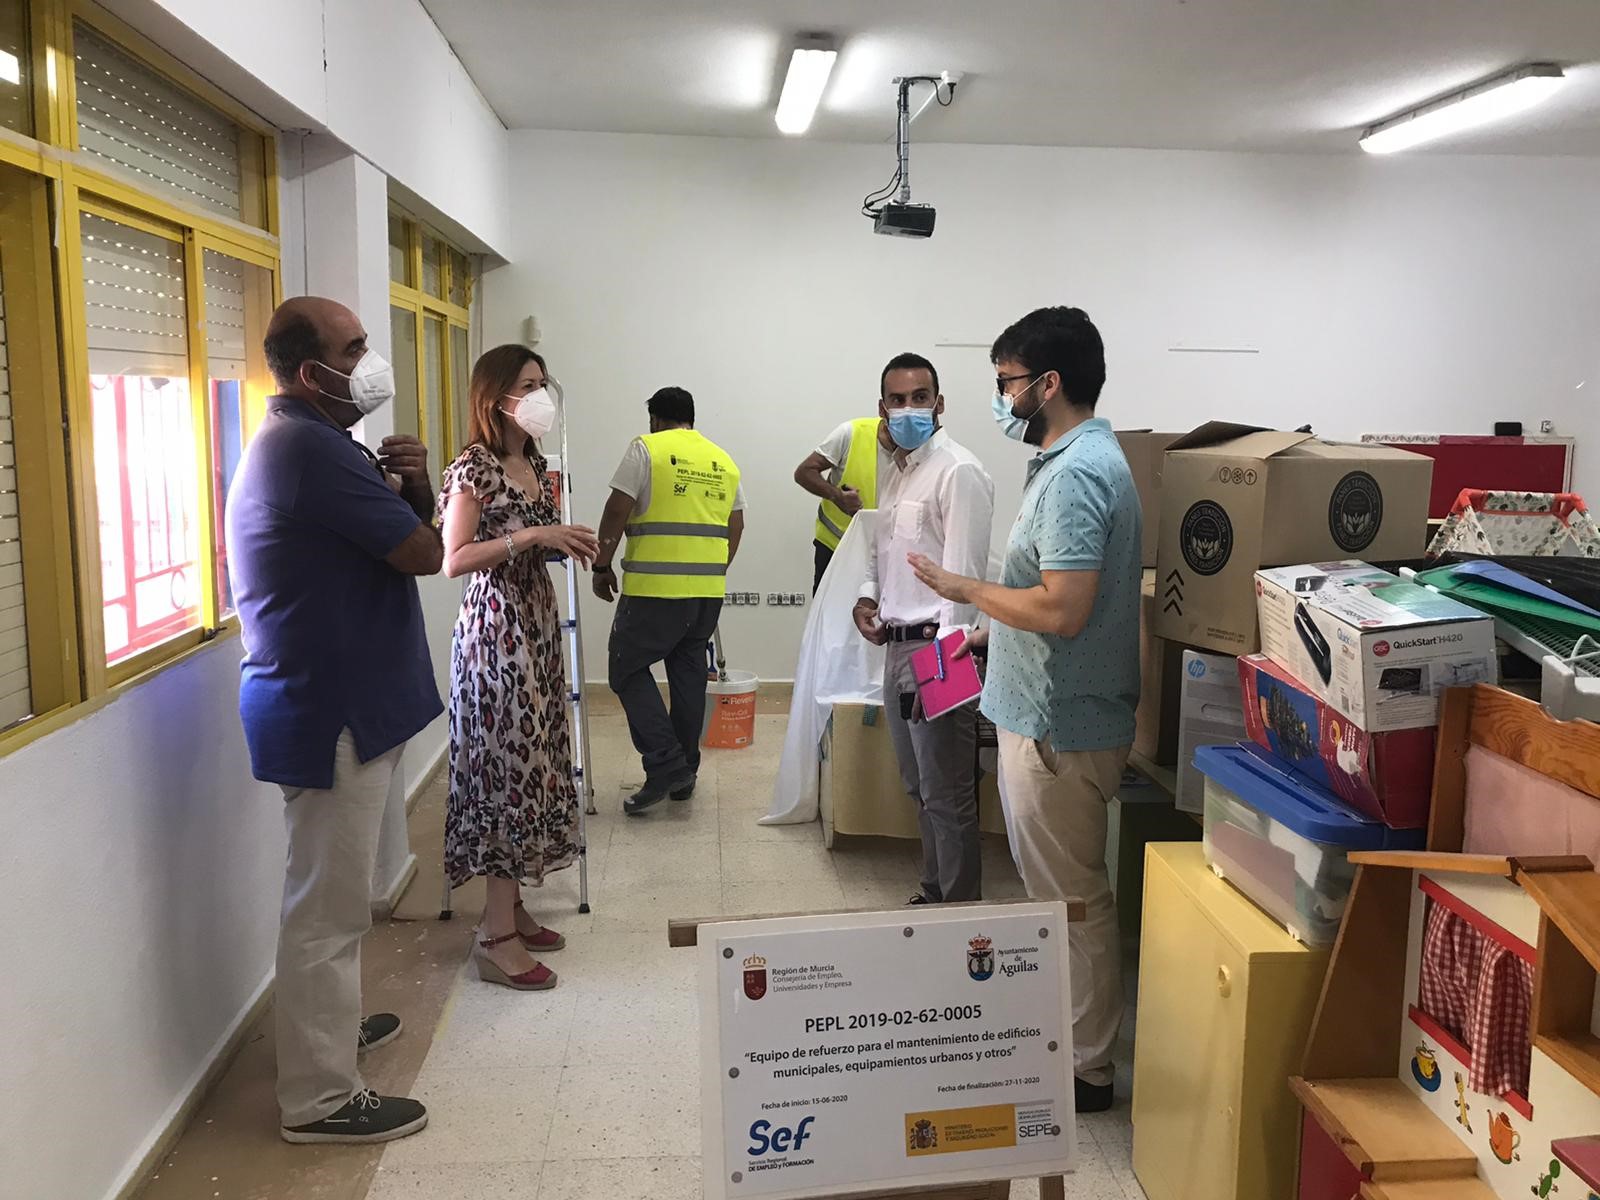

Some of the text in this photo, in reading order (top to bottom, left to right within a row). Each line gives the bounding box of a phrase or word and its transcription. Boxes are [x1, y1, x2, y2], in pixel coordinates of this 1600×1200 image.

[674, 483, 687, 493] Sef
[998, 947, 1039, 957] Ayuntamiento
[772, 967, 797, 976] Región
[810, 965, 835, 973] Murcia
[817, 972, 843, 980] Empleo,
[999, 960, 1039, 977] Águilas
[773, 983, 818, 992] Universidades
[805, 1004, 982, 1033] PEPL 2019-02-62-0005
[792, 1047, 806, 1059] de
[809, 1044, 855, 1057] refuerzo
[857, 1042, 881, 1054] para
[884, 1039, 894, 1050] el
[896, 1033, 979, 1049] mantenimiento
[982, 1030, 995, 1041] de
[997, 1027, 1041, 1040] edificios
[773, 1062, 843, 1078] municipales,
[845, 1054, 927, 1072] equipamientos
[929, 1050, 974, 1064] urbanos
[975, 1052, 982, 1062] y
[937, 1076, 1040, 1093] Fecha de finalización: 27-11-2020
[761, 1094, 848, 1110] Fecha de inicio: 15-06-2020
[747, 1115, 816, 1156] Sef
[1018, 1123, 1052, 1138] SEPE
[756, 1163, 777, 1171] EMPLEO
